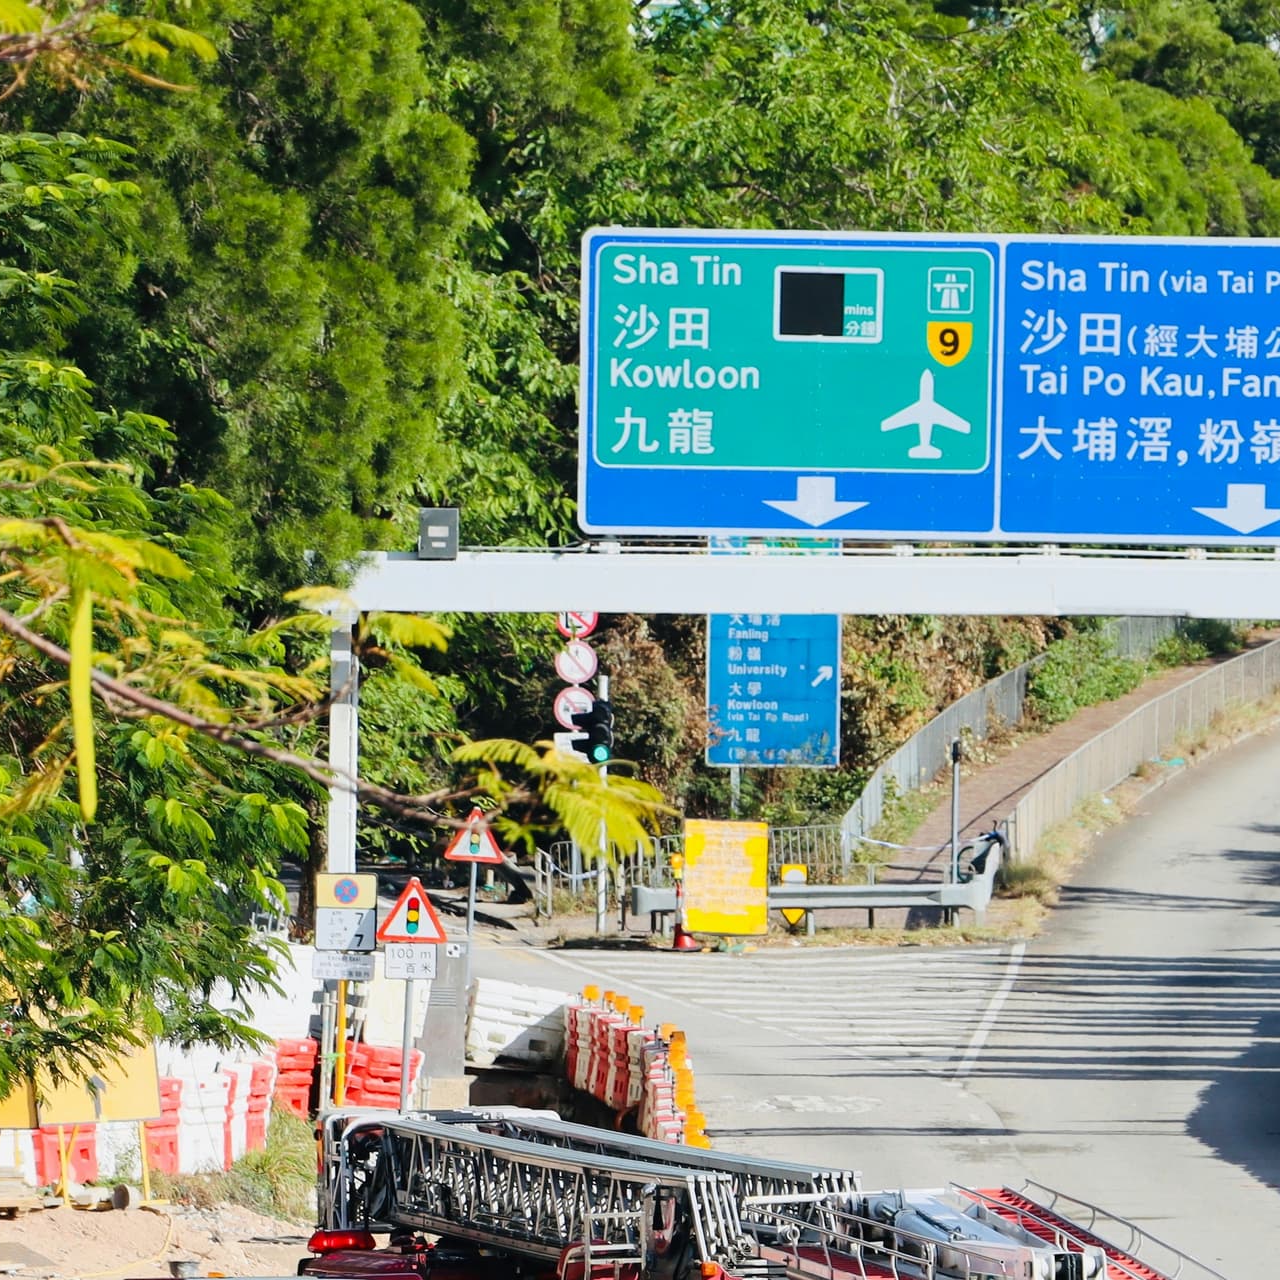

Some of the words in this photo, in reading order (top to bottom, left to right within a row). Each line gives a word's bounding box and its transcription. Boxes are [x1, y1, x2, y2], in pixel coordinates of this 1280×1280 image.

[613, 254, 678, 286] Sha
[690, 255, 743, 286] Tin
[1020, 260, 1087, 292] Sha
[1099, 262, 1150, 295] Tin
[1160, 273, 1207, 298] (via
[1218, 272, 1253, 295] Tai
[844, 304, 874, 316] mins
[612, 304, 710, 350] 沙田
[939, 327, 960, 357] 9
[610, 358, 760, 390] Kowloon
[1019, 364, 1068, 396] Tai
[1083, 366, 1126, 398] Po
[611, 407, 716, 455] 九龍
[728, 628, 769, 643] Fanling
[728, 663, 788, 678] University
[728, 681, 762, 697] 大學
[728, 699, 779, 711] Kowloon
[728, 727, 761, 743] 九龍
[355, 912, 364, 926] 7
[355, 934, 365, 947] 7
[391, 949, 414, 960] 100
[420, 950, 432, 960] m
[389, 962, 432, 974] 一百米
